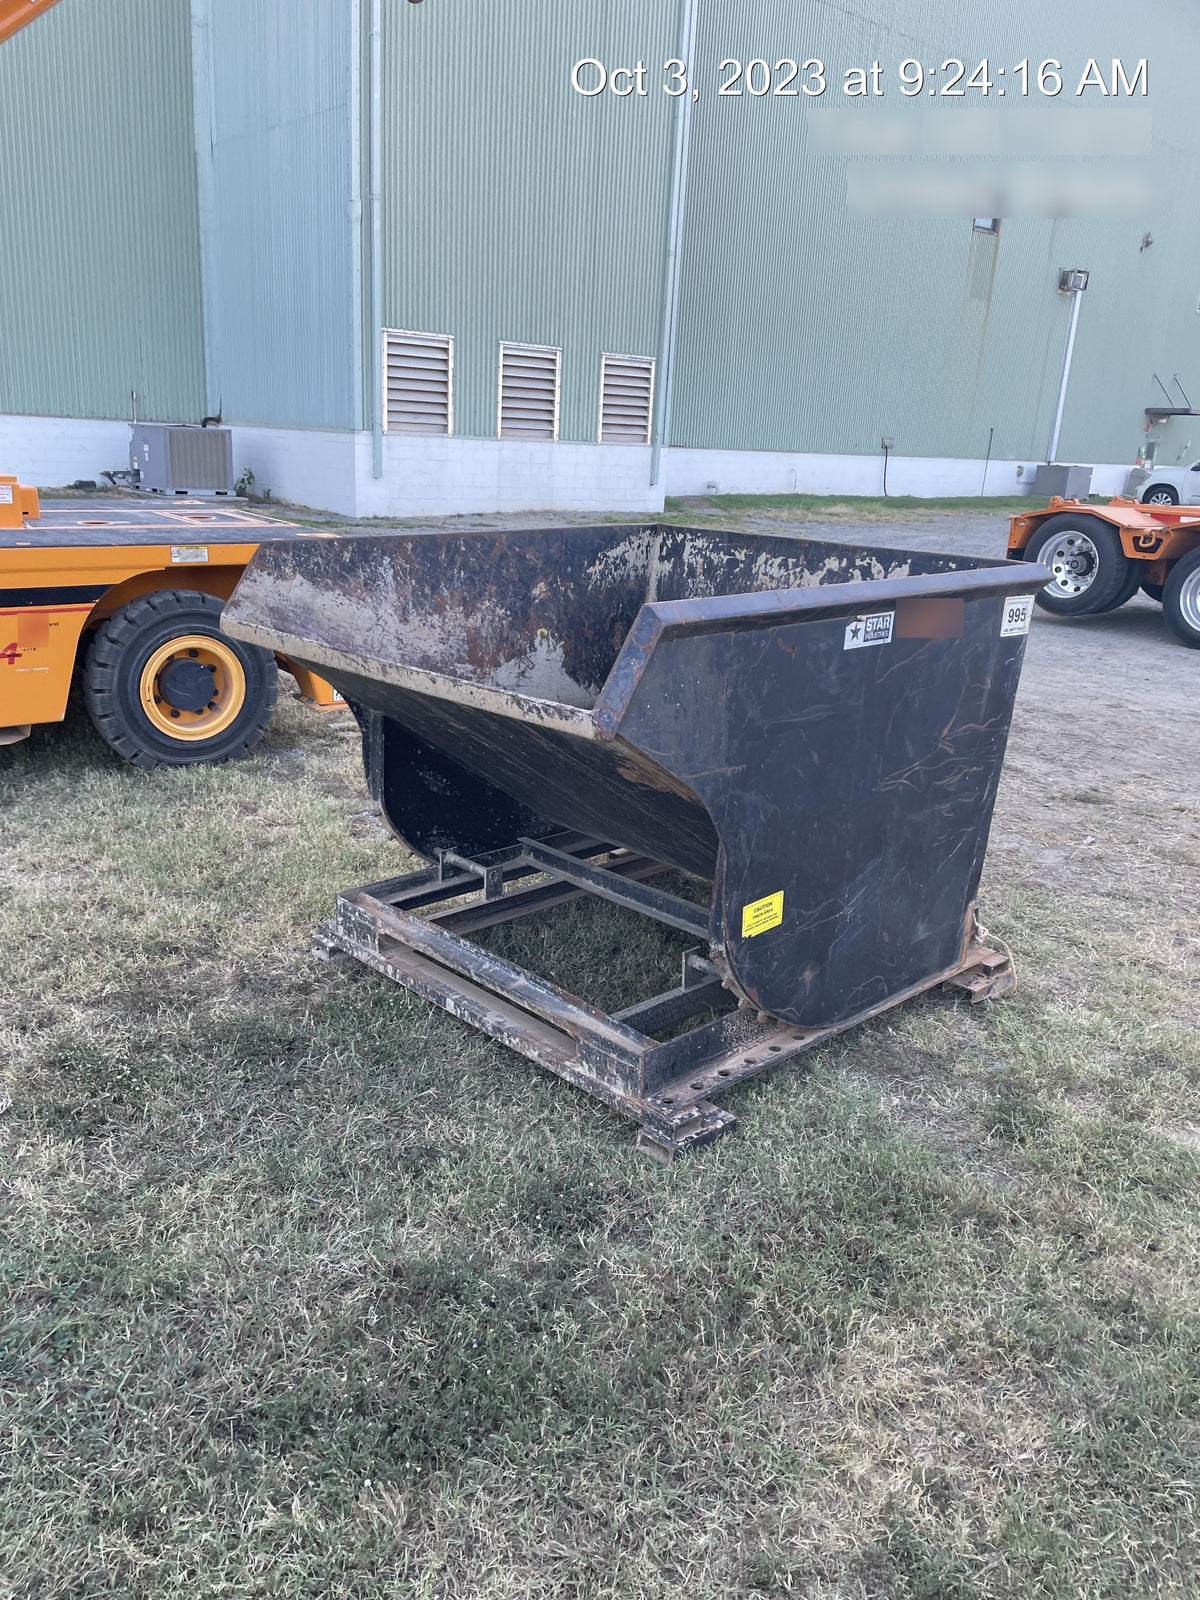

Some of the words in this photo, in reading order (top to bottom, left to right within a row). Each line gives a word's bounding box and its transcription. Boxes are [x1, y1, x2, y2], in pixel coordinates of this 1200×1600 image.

[1008, 607, 1026, 623] 995
[866, 616, 890, 631] STAR
[754, 902, 773, 913] CAUTION
